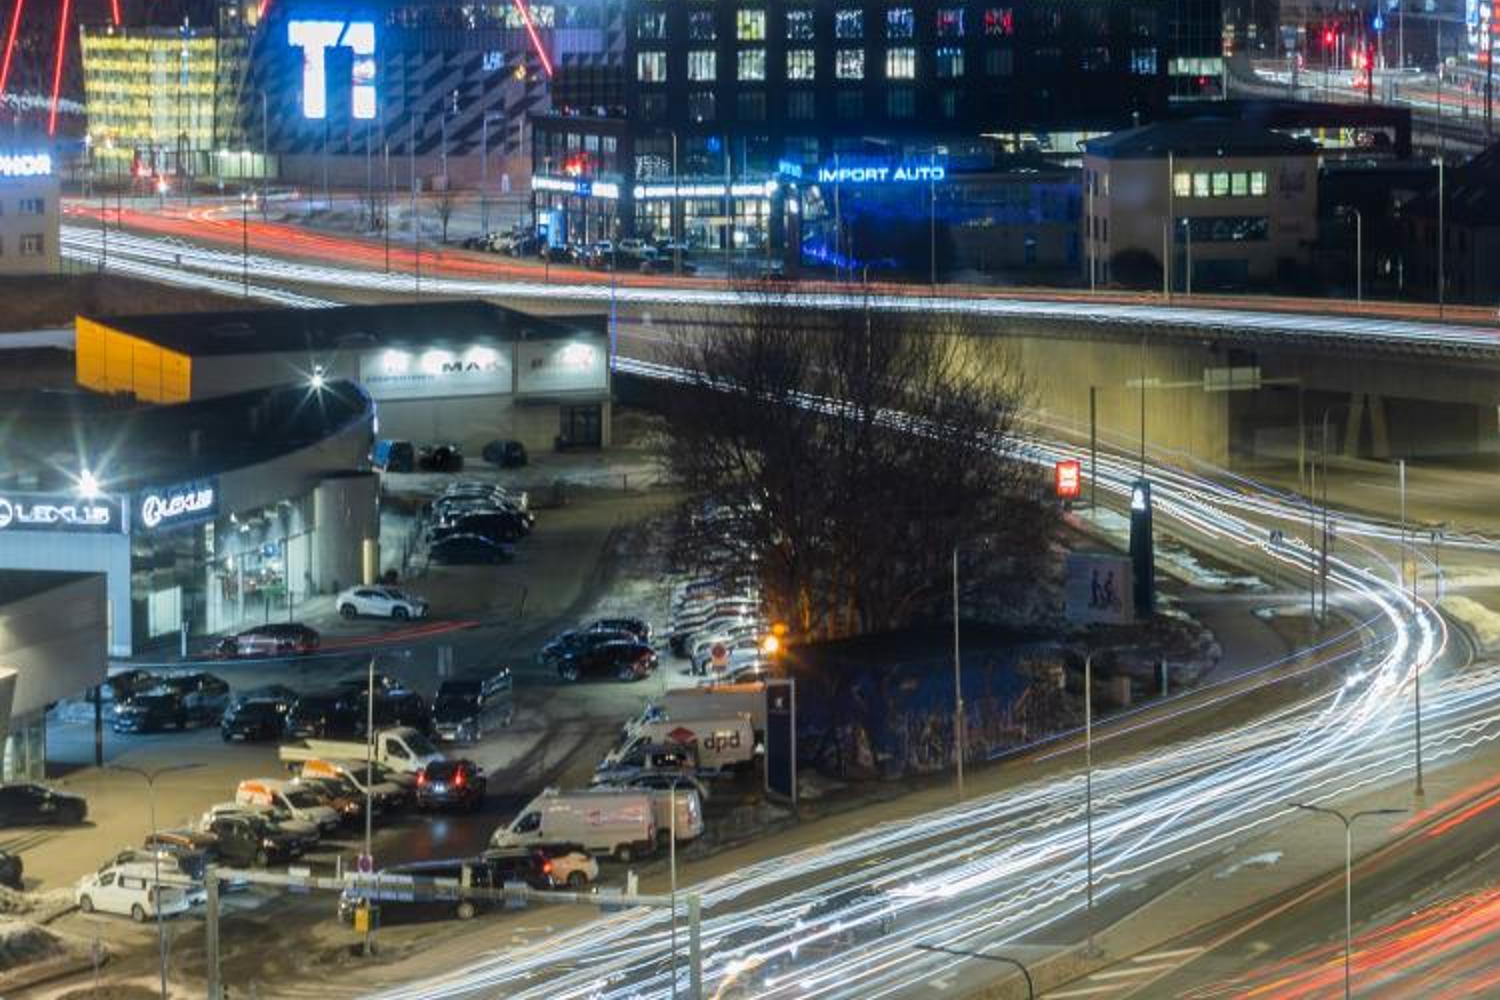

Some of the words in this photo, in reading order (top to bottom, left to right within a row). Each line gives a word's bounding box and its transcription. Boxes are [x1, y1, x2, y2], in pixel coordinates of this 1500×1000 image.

[818, 167, 889, 182] IMPORT
[894, 166, 945, 181] AUTO
[159, 488, 213, 517] LEXUS
[15, 503, 110, 525] LEXUS
[704, 731, 740, 754] dpd
